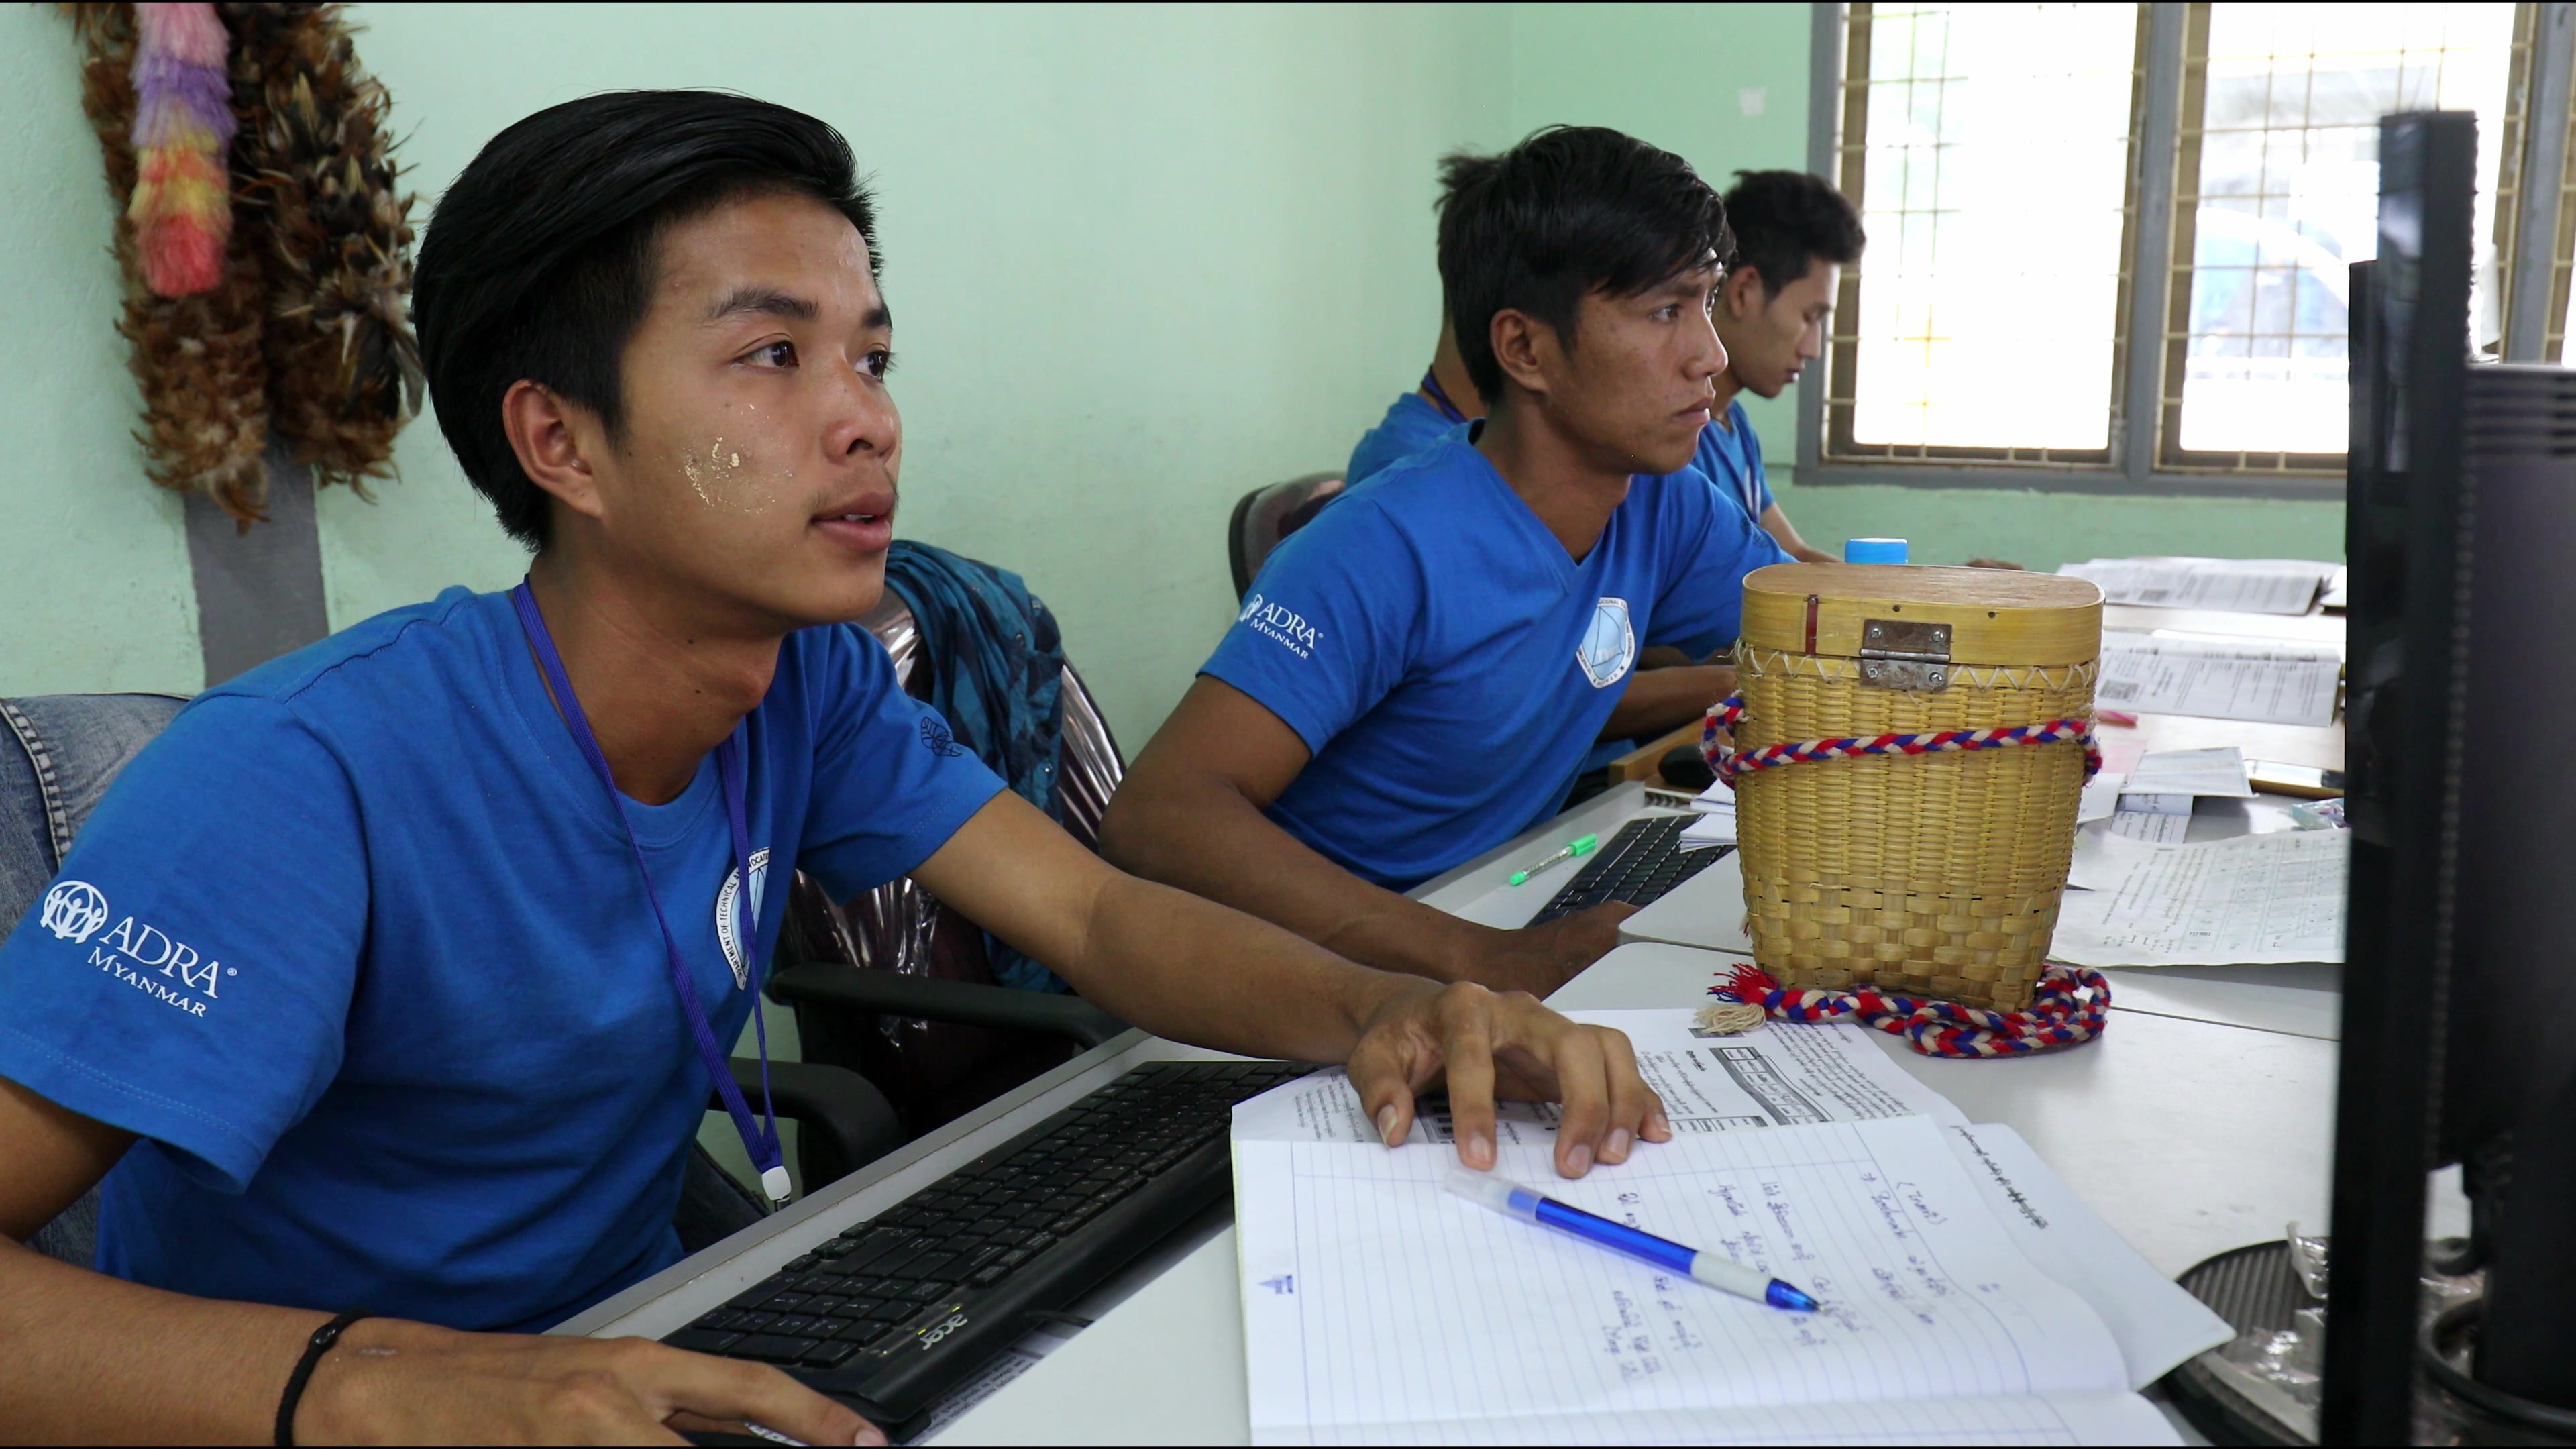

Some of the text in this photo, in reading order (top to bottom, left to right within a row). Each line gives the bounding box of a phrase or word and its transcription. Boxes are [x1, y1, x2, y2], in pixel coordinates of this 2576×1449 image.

[1250, 618, 1308, 659] MYANMAR
[1256, 602, 1315, 649] ADRA
[719, 881, 737, 921] TECHNICAL
[721, 922, 729, 934] OF
[99, 916, 219, 998] ADRA
[87, 946, 207, 1017] MYANMAR
[919, 1313, 968, 1350] acer
